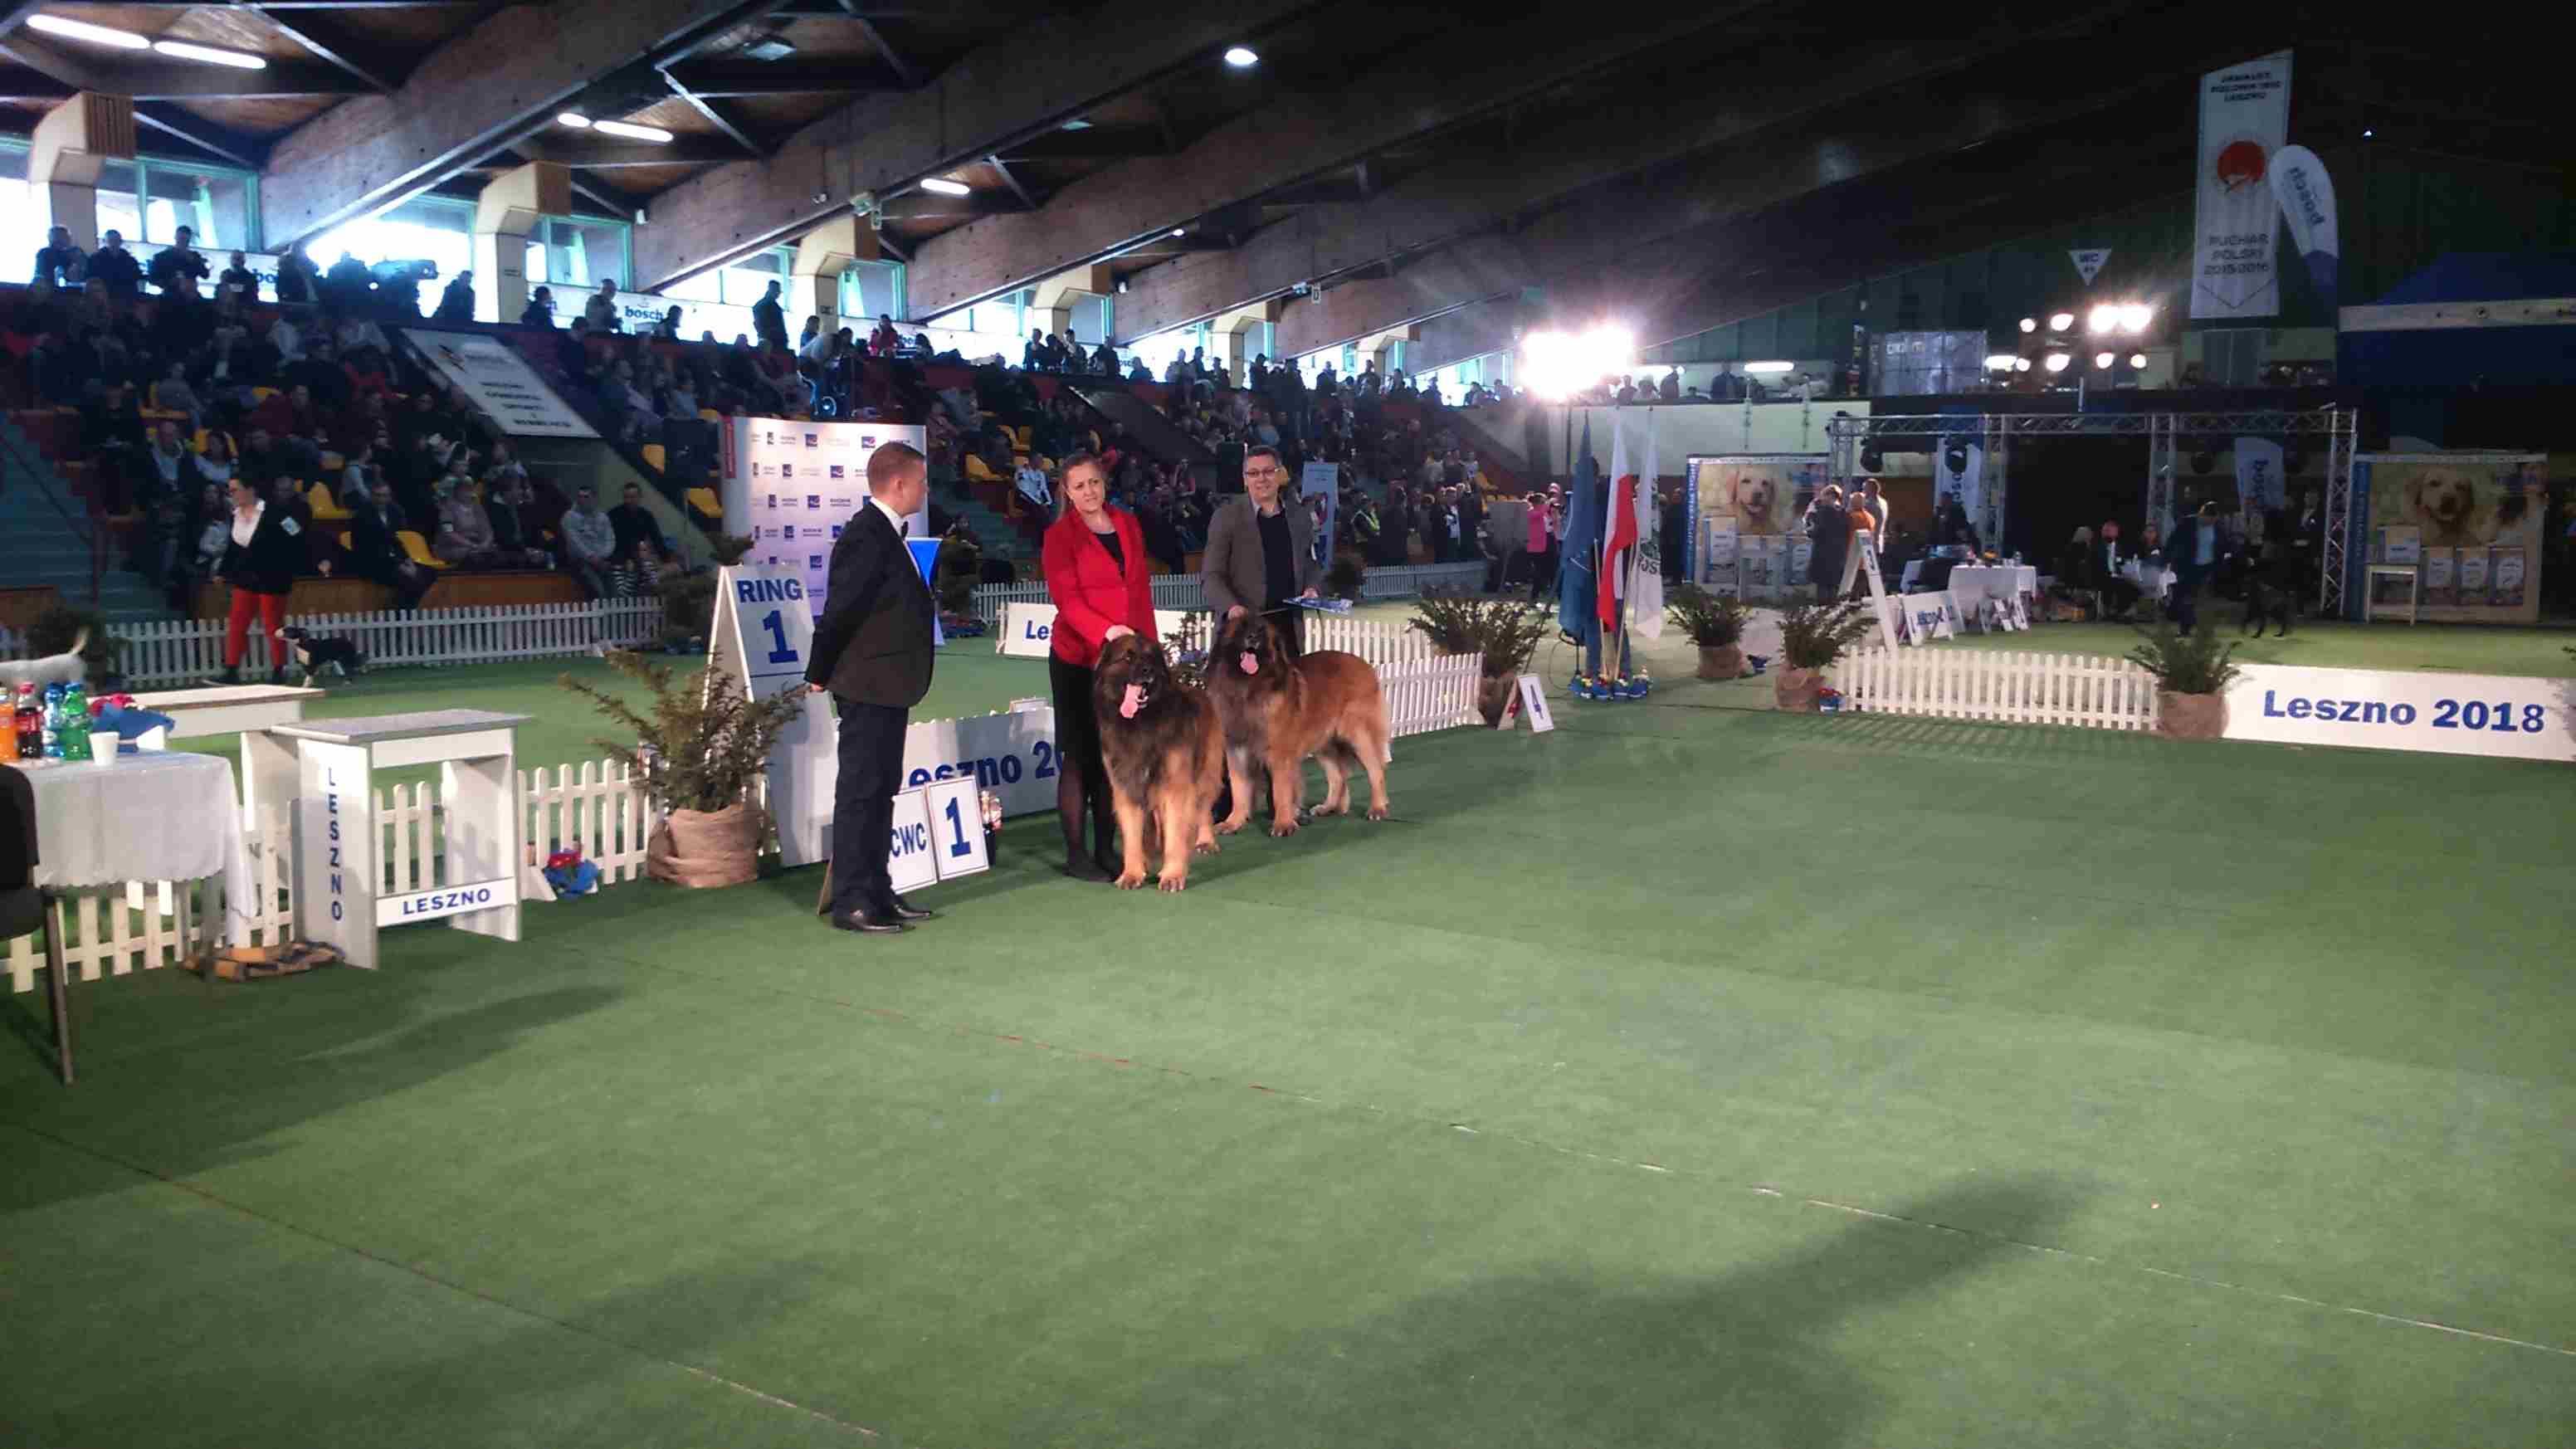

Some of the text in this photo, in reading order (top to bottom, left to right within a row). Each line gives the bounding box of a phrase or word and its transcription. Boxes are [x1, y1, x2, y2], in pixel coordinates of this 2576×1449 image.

[2079, 253, 2099, 263] WC
[624, 305, 665, 320] bosch
[736, 578, 804, 603] RING
[763, 610, 799, 664] 1
[2263, 690, 2545, 733] Leszno 2018
[909, 754, 1022, 788] eszno
[328, 767, 344, 921] LESZNO
[944, 796, 972, 858] 1
[402, 888, 492, 915] LESZNO
